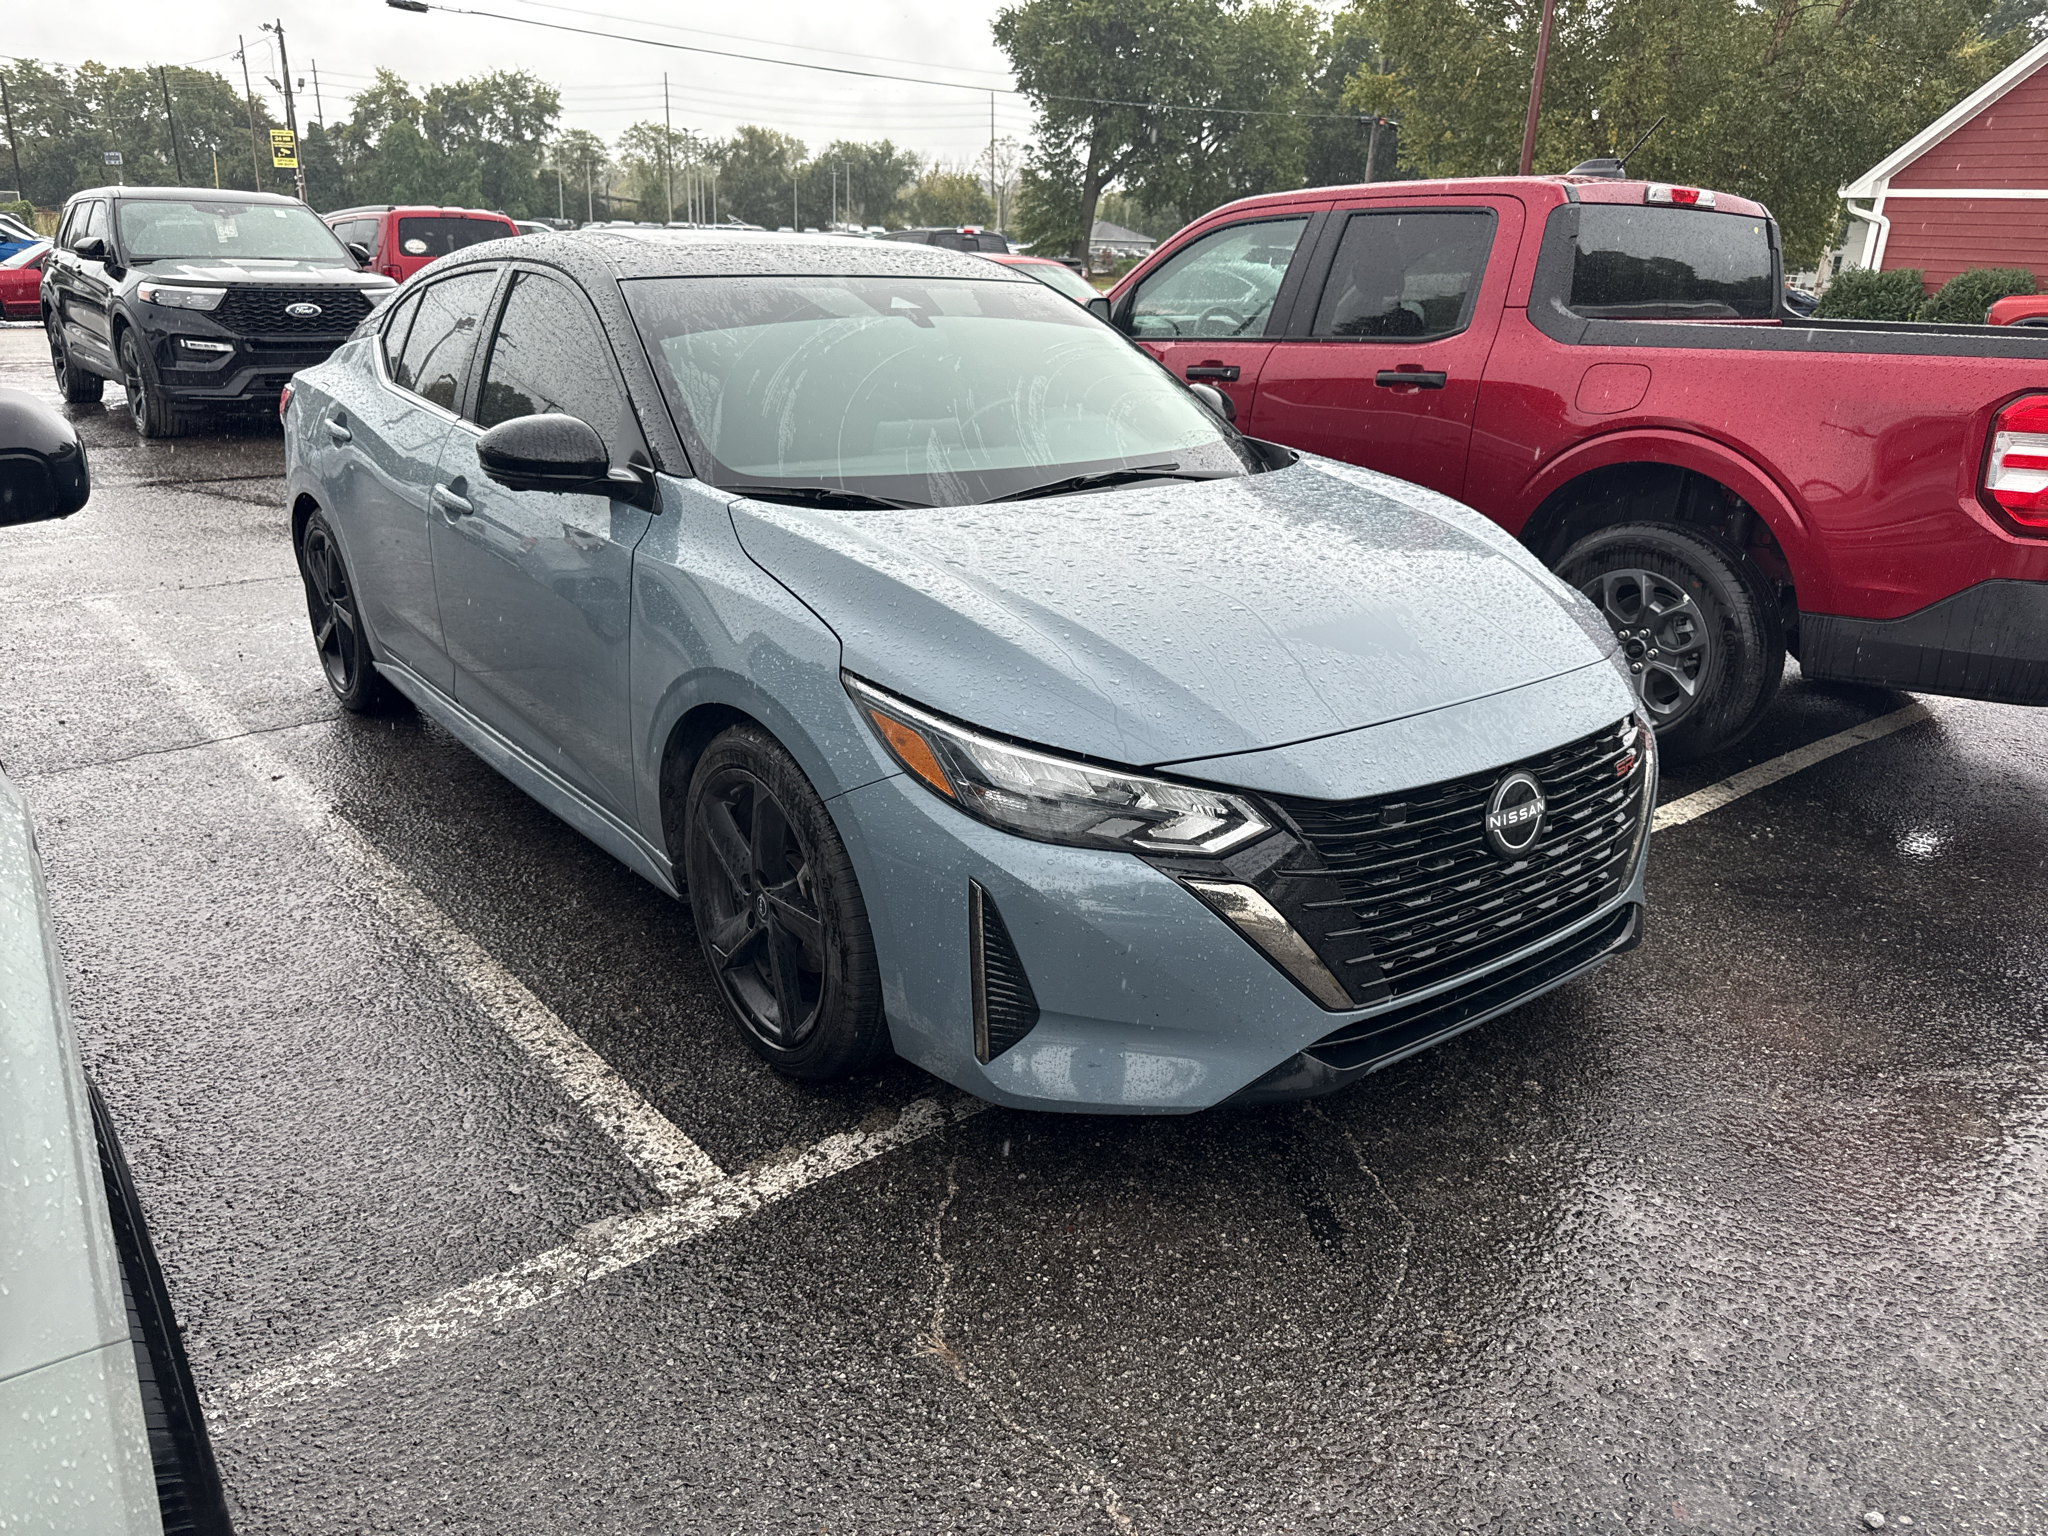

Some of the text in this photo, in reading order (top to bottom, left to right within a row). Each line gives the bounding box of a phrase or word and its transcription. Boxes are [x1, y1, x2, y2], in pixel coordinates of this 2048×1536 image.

[295, 306, 314, 314] Ford
[1615, 755, 1635, 777] SR
[1488, 799, 1545, 829] NISSAN
